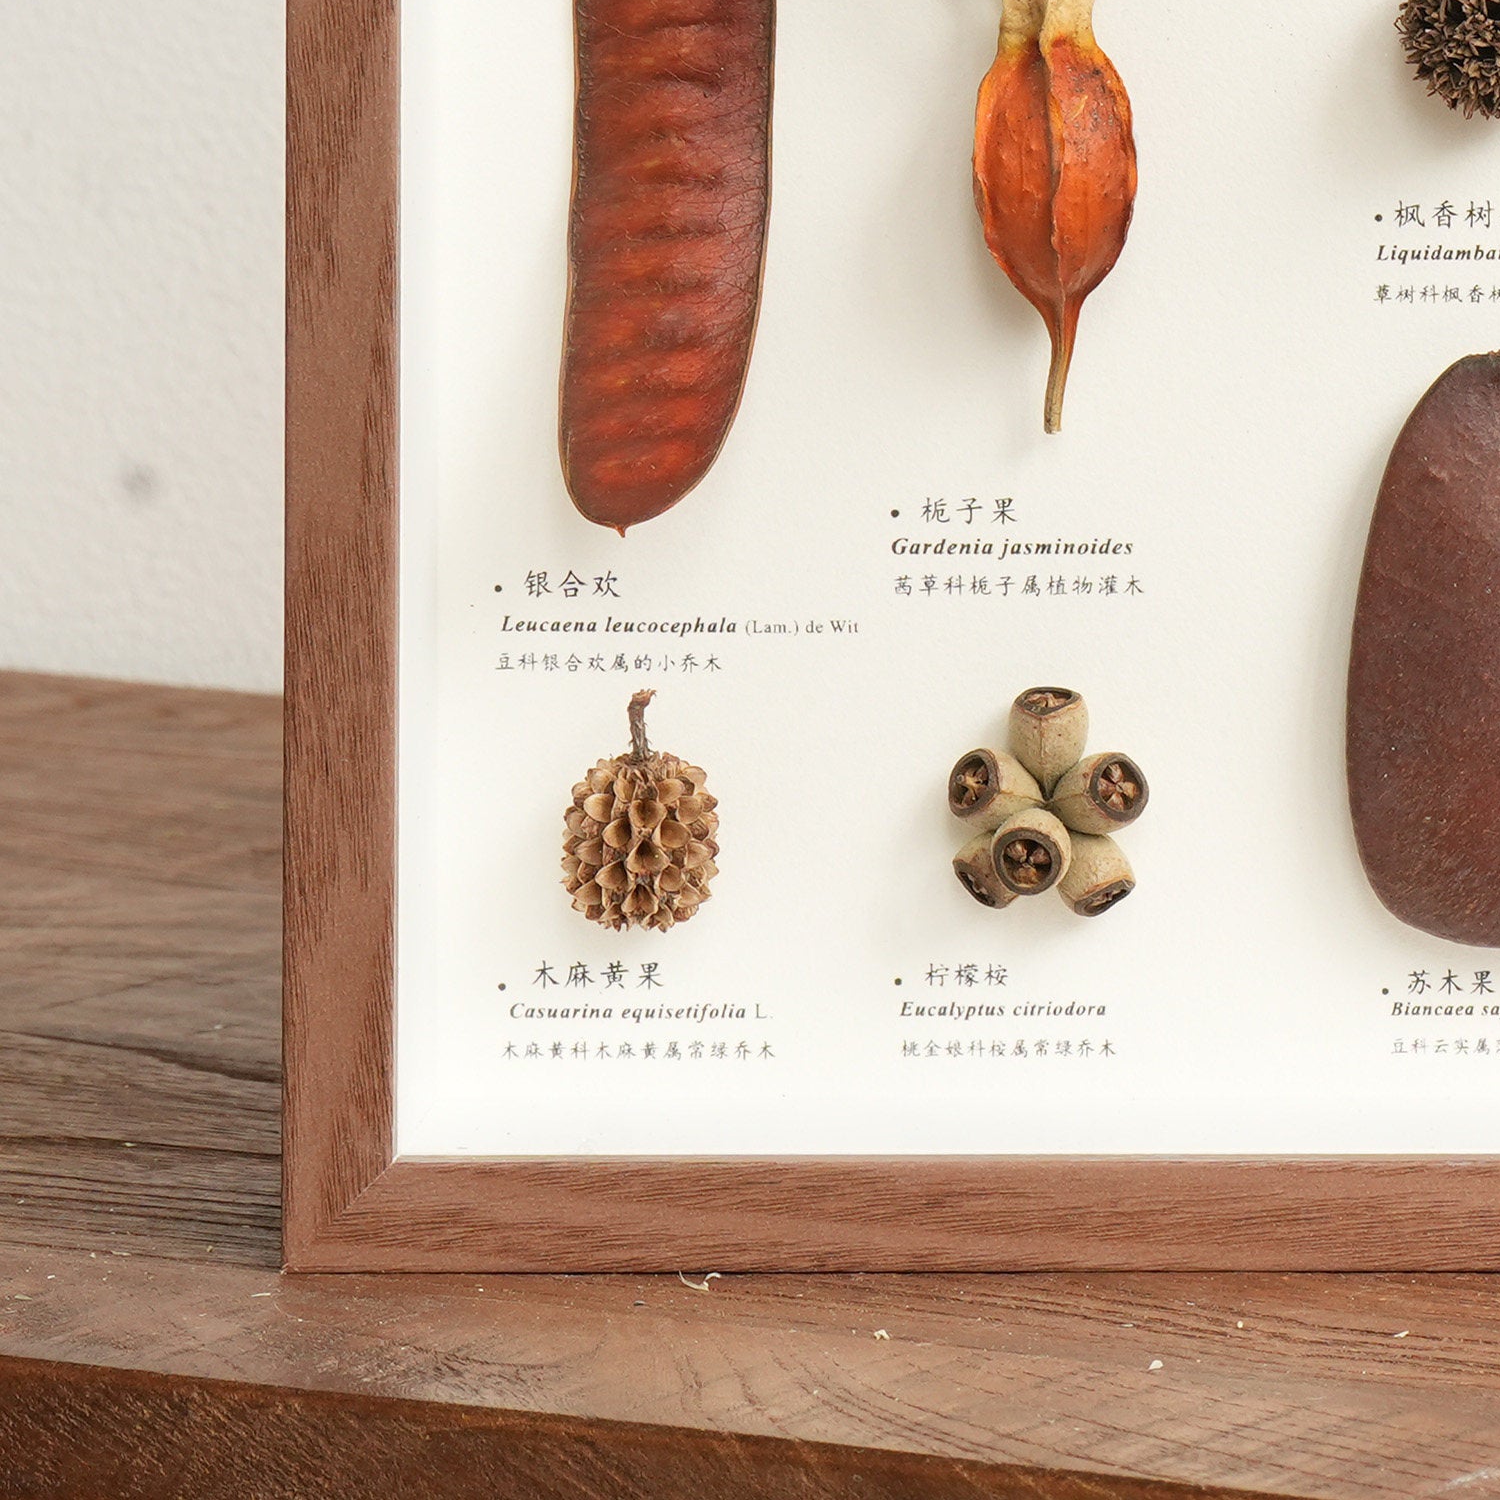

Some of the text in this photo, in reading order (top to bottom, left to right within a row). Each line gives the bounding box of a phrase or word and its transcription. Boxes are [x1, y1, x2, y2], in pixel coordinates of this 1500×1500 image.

[920, 496, 1019, 526] 栀子果
[890, 536, 1134, 561] Gardenia jasminoides
[523, 569, 622, 599] 银合欢
[893, 573, 1145, 598] 茜草科栀子属植物灌木
[500, 614, 860, 638] Leucaena leucocephala (Lam.) de Wit
[494, 651, 723, 674] 豆科银合欢属的小乔木
[531, 959, 665, 991] 木麻黄果
[924, 962, 1009, 988] 柠檬桉
[1407, 968, 1495, 996] 苏木果
[509, 1001, 614, 1020] Casuarina
[621, 1001, 747, 1024] equisetifolia
[899, 1000, 1107, 1021] Eucalyptus citriodora
[1390, 1001, 1475, 1017] Biancaea
[501, 1039, 776, 1062] 木麻黄科木麻黄属常绿乔木
[900, 1038, 1118, 1059] 桃金娘科桉属常绿乔木
